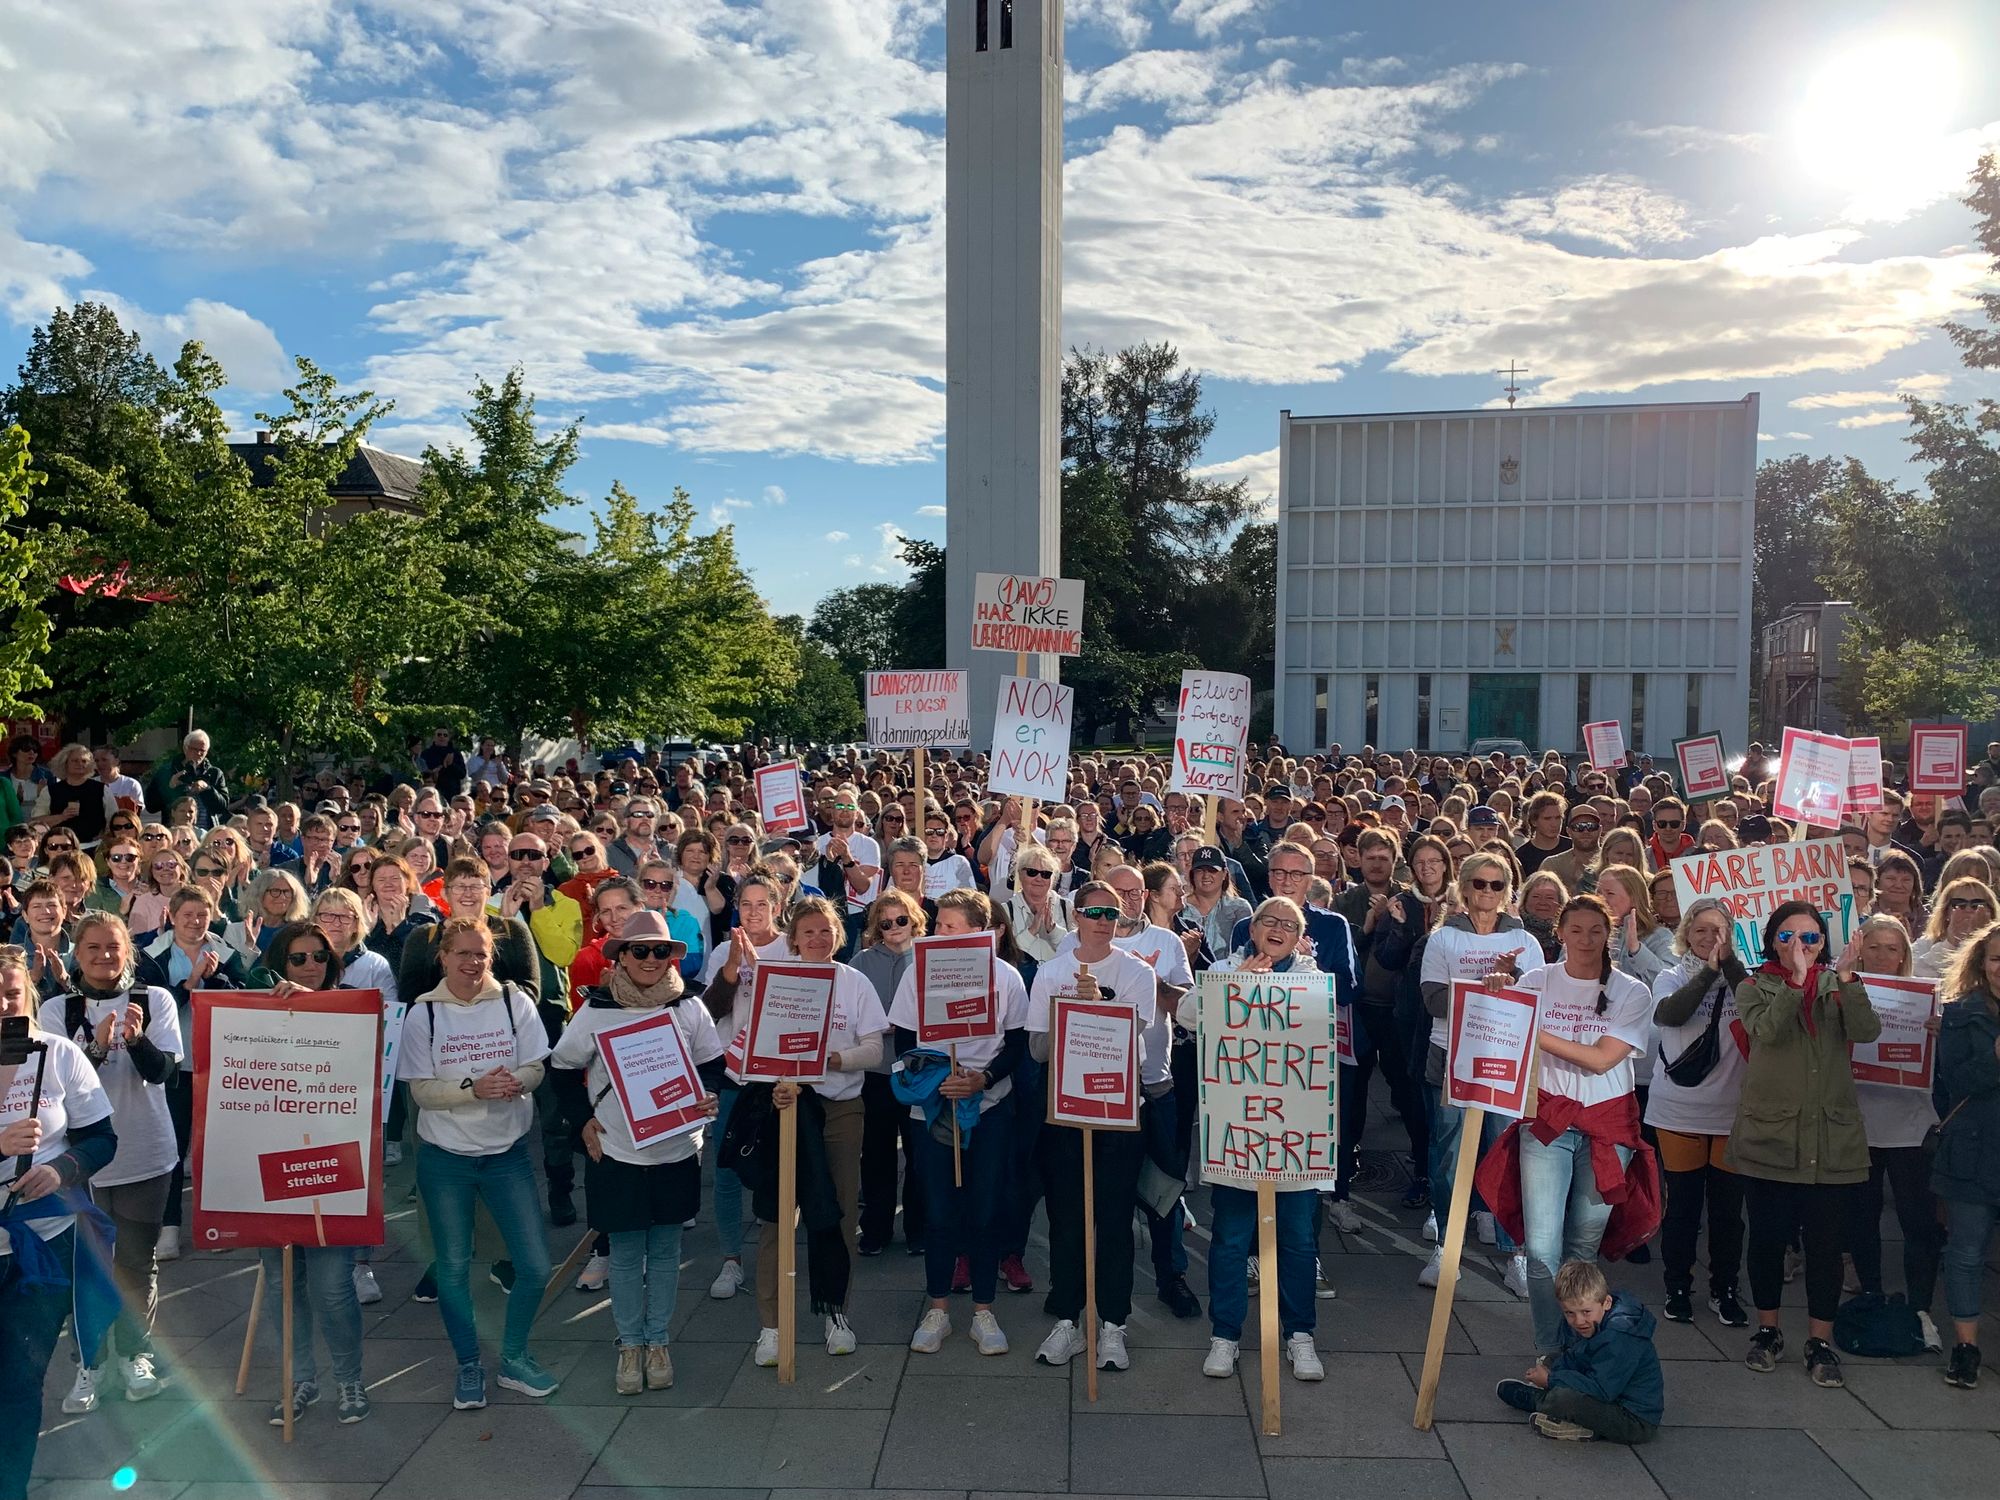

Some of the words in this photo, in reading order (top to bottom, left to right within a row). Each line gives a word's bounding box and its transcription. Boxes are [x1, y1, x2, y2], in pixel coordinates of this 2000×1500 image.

[1003, 578, 1013, 602] 1
[1016, 582, 1040, 605] AV
[1038, 580, 1054, 606] 5
[978, 603, 1015, 622] HAR
[1023, 606, 1068, 626] IKKE
[896, 700, 912, 714] ER
[916, 696, 948, 712] OGSÅ
[1006, 681, 1069, 724] NOK
[1016, 724, 1046, 744] er
[1206, 732, 1224, 742] en
[1190, 743, 1234, 764] EKTE
[996, 749, 1060, 786] NOK
[1201, 849, 1212, 858] NY
[1682, 852, 1765, 894] VÅRE
[1772, 843, 1844, 885] BARN
[768, 1001, 800, 1011] elevene,
[1224, 982, 1308, 1031] BARE
[788, 1010, 821, 1021] lærerne!
[496, 1030, 504, 1038] på
[1467, 1020, 1497, 1034] elevene,
[224, 1034, 248, 1044] Kjære
[249, 1036, 288, 1044] politikere
[313, 1038, 340, 1046] partier
[440, 1042, 483, 1054] elevene,
[1070, 1039, 1101, 1050] elevene,
[1482, 1033, 1520, 1049] lærerne!
[459, 1055, 467, 1064] på
[624, 1056, 656, 1070] elevene,
[1090, 1050, 1123, 1061] lærerne!
[1202, 1033, 1328, 1090] LÆRERE
[224, 1057, 246, 1069] Skal
[249, 1059, 277, 1070] dere
[280, 1062, 312, 1072] satse
[315, 1062, 331, 1075] på
[647, 1058, 680, 1072] lærerne!
[1483, 1068, 1506, 1076] streiker
[24, 1076, 34, 1086] på
[222, 1073, 302, 1095] elevene,
[306, 1082, 326, 1093] må
[329, 1083, 357, 1094] dere
[12, 1091, 26, 1099] må
[659, 1083, 680, 1096] Lærerne
[220, 1100, 251, 1111] satse
[254, 1100, 270, 1114] på
[274, 1095, 357, 1114] lærerne!
[1244, 1095, 1284, 1123] ER
[1205, 1113, 1330, 1172] LÆRERE
[282, 1157, 338, 1173] Lærerne
[287, 1172, 338, 1189] streiker
